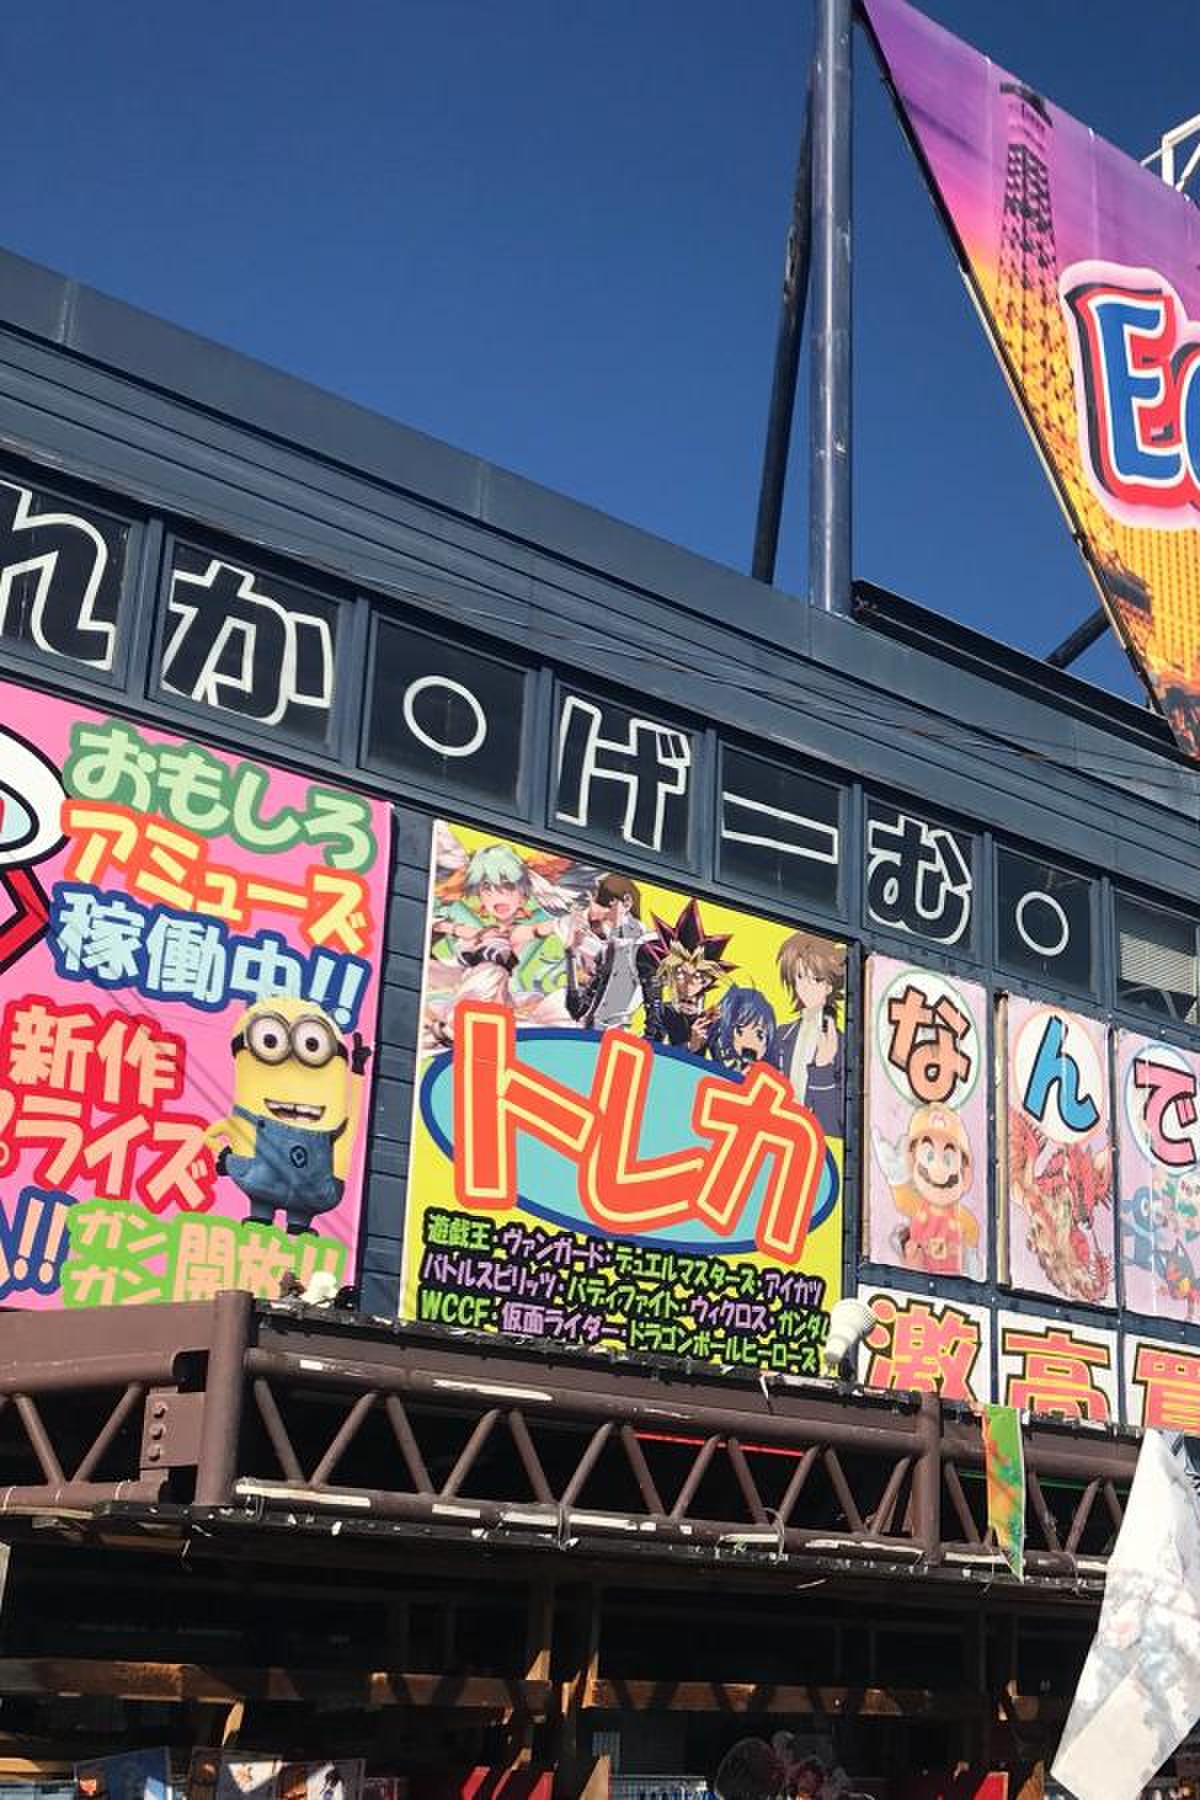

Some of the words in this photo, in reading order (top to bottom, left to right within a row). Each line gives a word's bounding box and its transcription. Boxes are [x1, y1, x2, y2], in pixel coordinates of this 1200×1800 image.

[70, 724, 374, 870] おもしろ
[64, 806, 372, 954] アミューズ
[9, 1004, 184, 1106] 新作
[453, 1003, 824, 1262] トレカ
[76, 1208, 166, 1258] ガン
